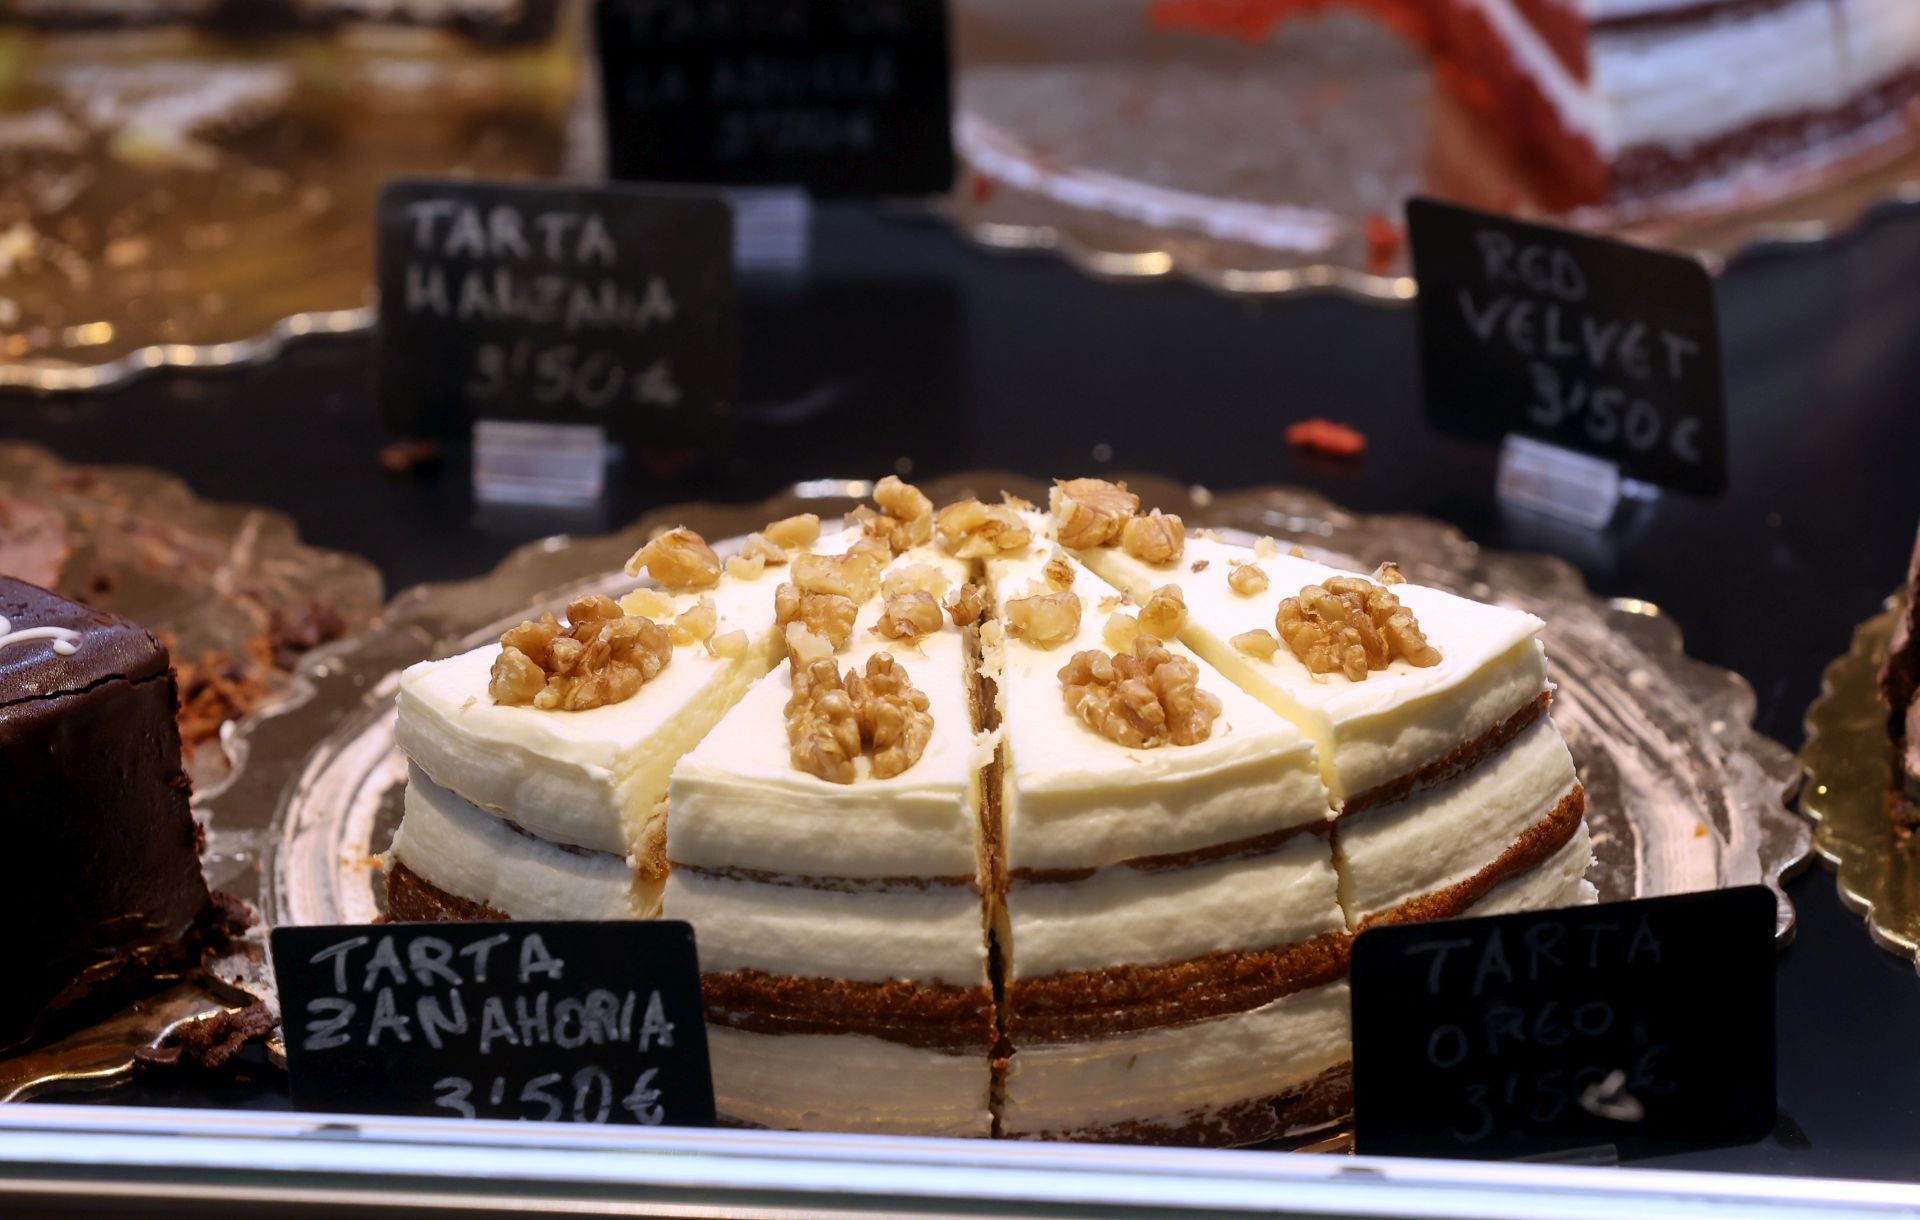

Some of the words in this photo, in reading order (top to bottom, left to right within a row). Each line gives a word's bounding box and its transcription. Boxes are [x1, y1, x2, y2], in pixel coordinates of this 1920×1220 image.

[406, 200, 618, 266] TARTA
[1473, 230, 1587, 302] RED
[1457, 287, 1700, 380] VELVET
[310, 933, 564, 993] TARTA
[1404, 914, 1662, 997] TARTA
[303, 987, 675, 1053] ZANAHORIA
